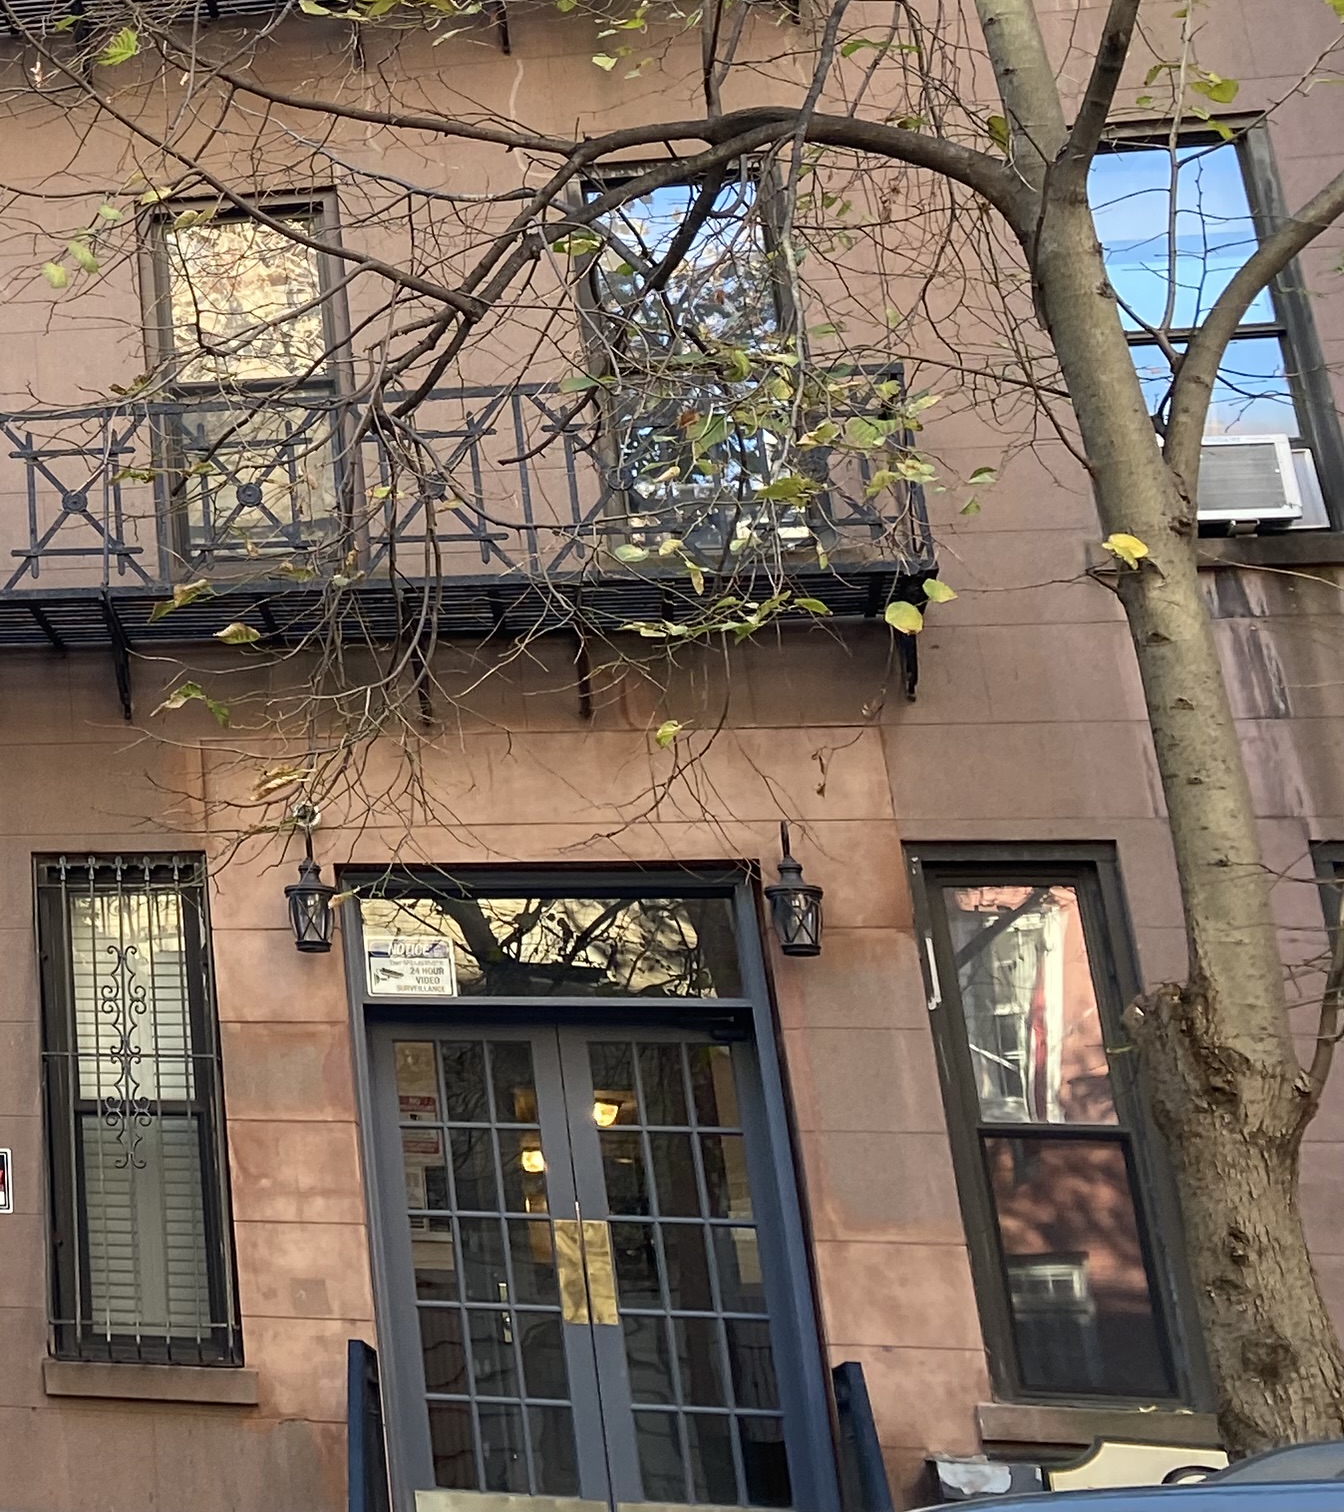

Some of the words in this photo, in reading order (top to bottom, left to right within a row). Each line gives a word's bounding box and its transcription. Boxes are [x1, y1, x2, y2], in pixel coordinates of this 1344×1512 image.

[409, 967, 422, 975] 24
[422, 967, 445, 975] HOUR
[415, 976, 441, 984] VIDEO
